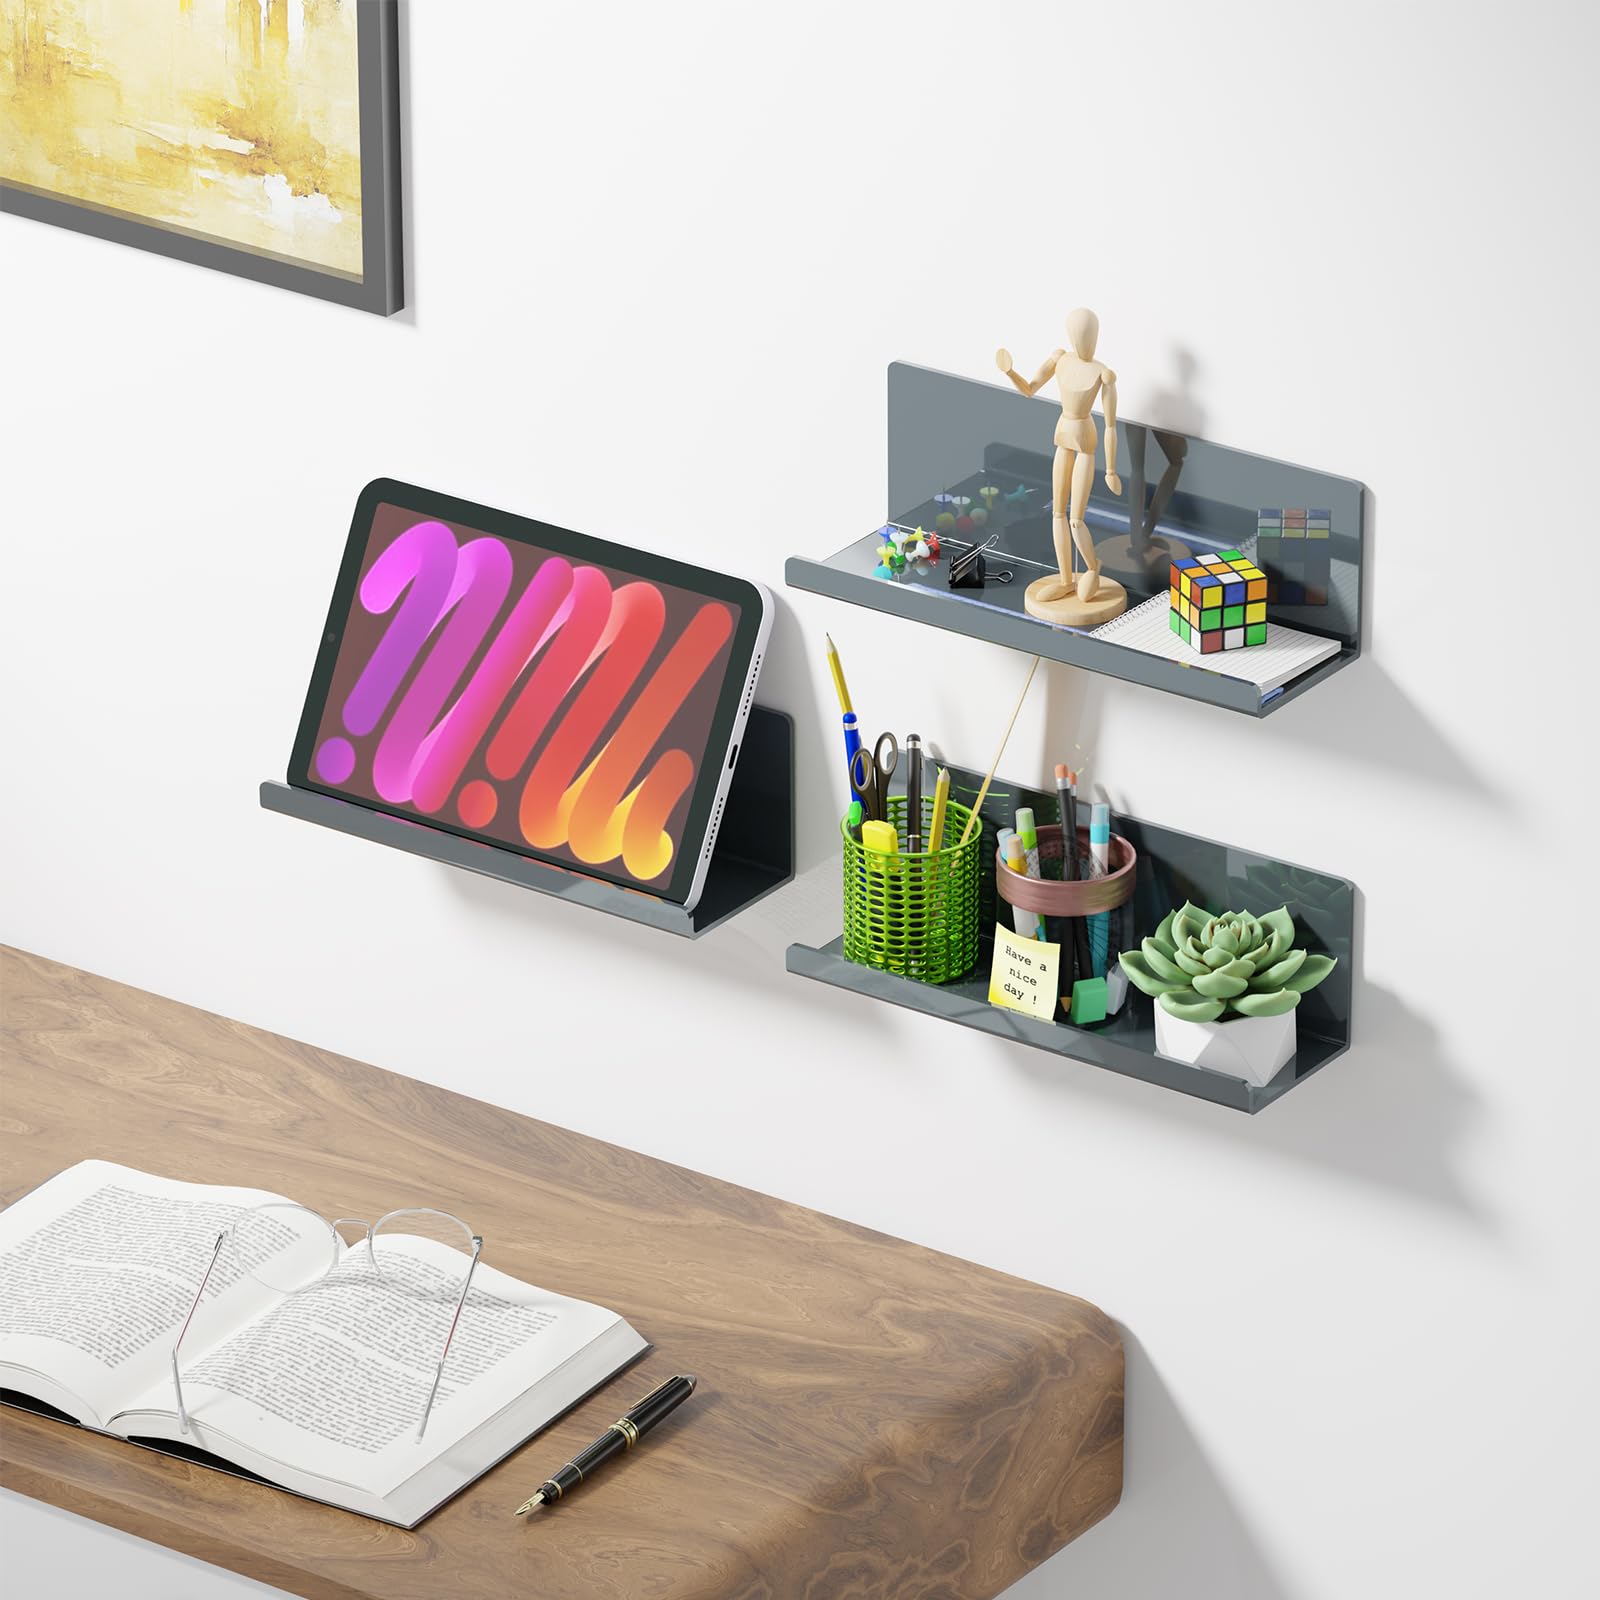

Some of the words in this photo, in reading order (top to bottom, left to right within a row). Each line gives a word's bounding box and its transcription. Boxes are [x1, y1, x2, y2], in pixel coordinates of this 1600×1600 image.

[1005, 945, 1032, 966] Have
[1039, 963, 1048, 972] a
[1009, 967, 1037, 986] nice
[1003, 983, 1025, 1001] day
